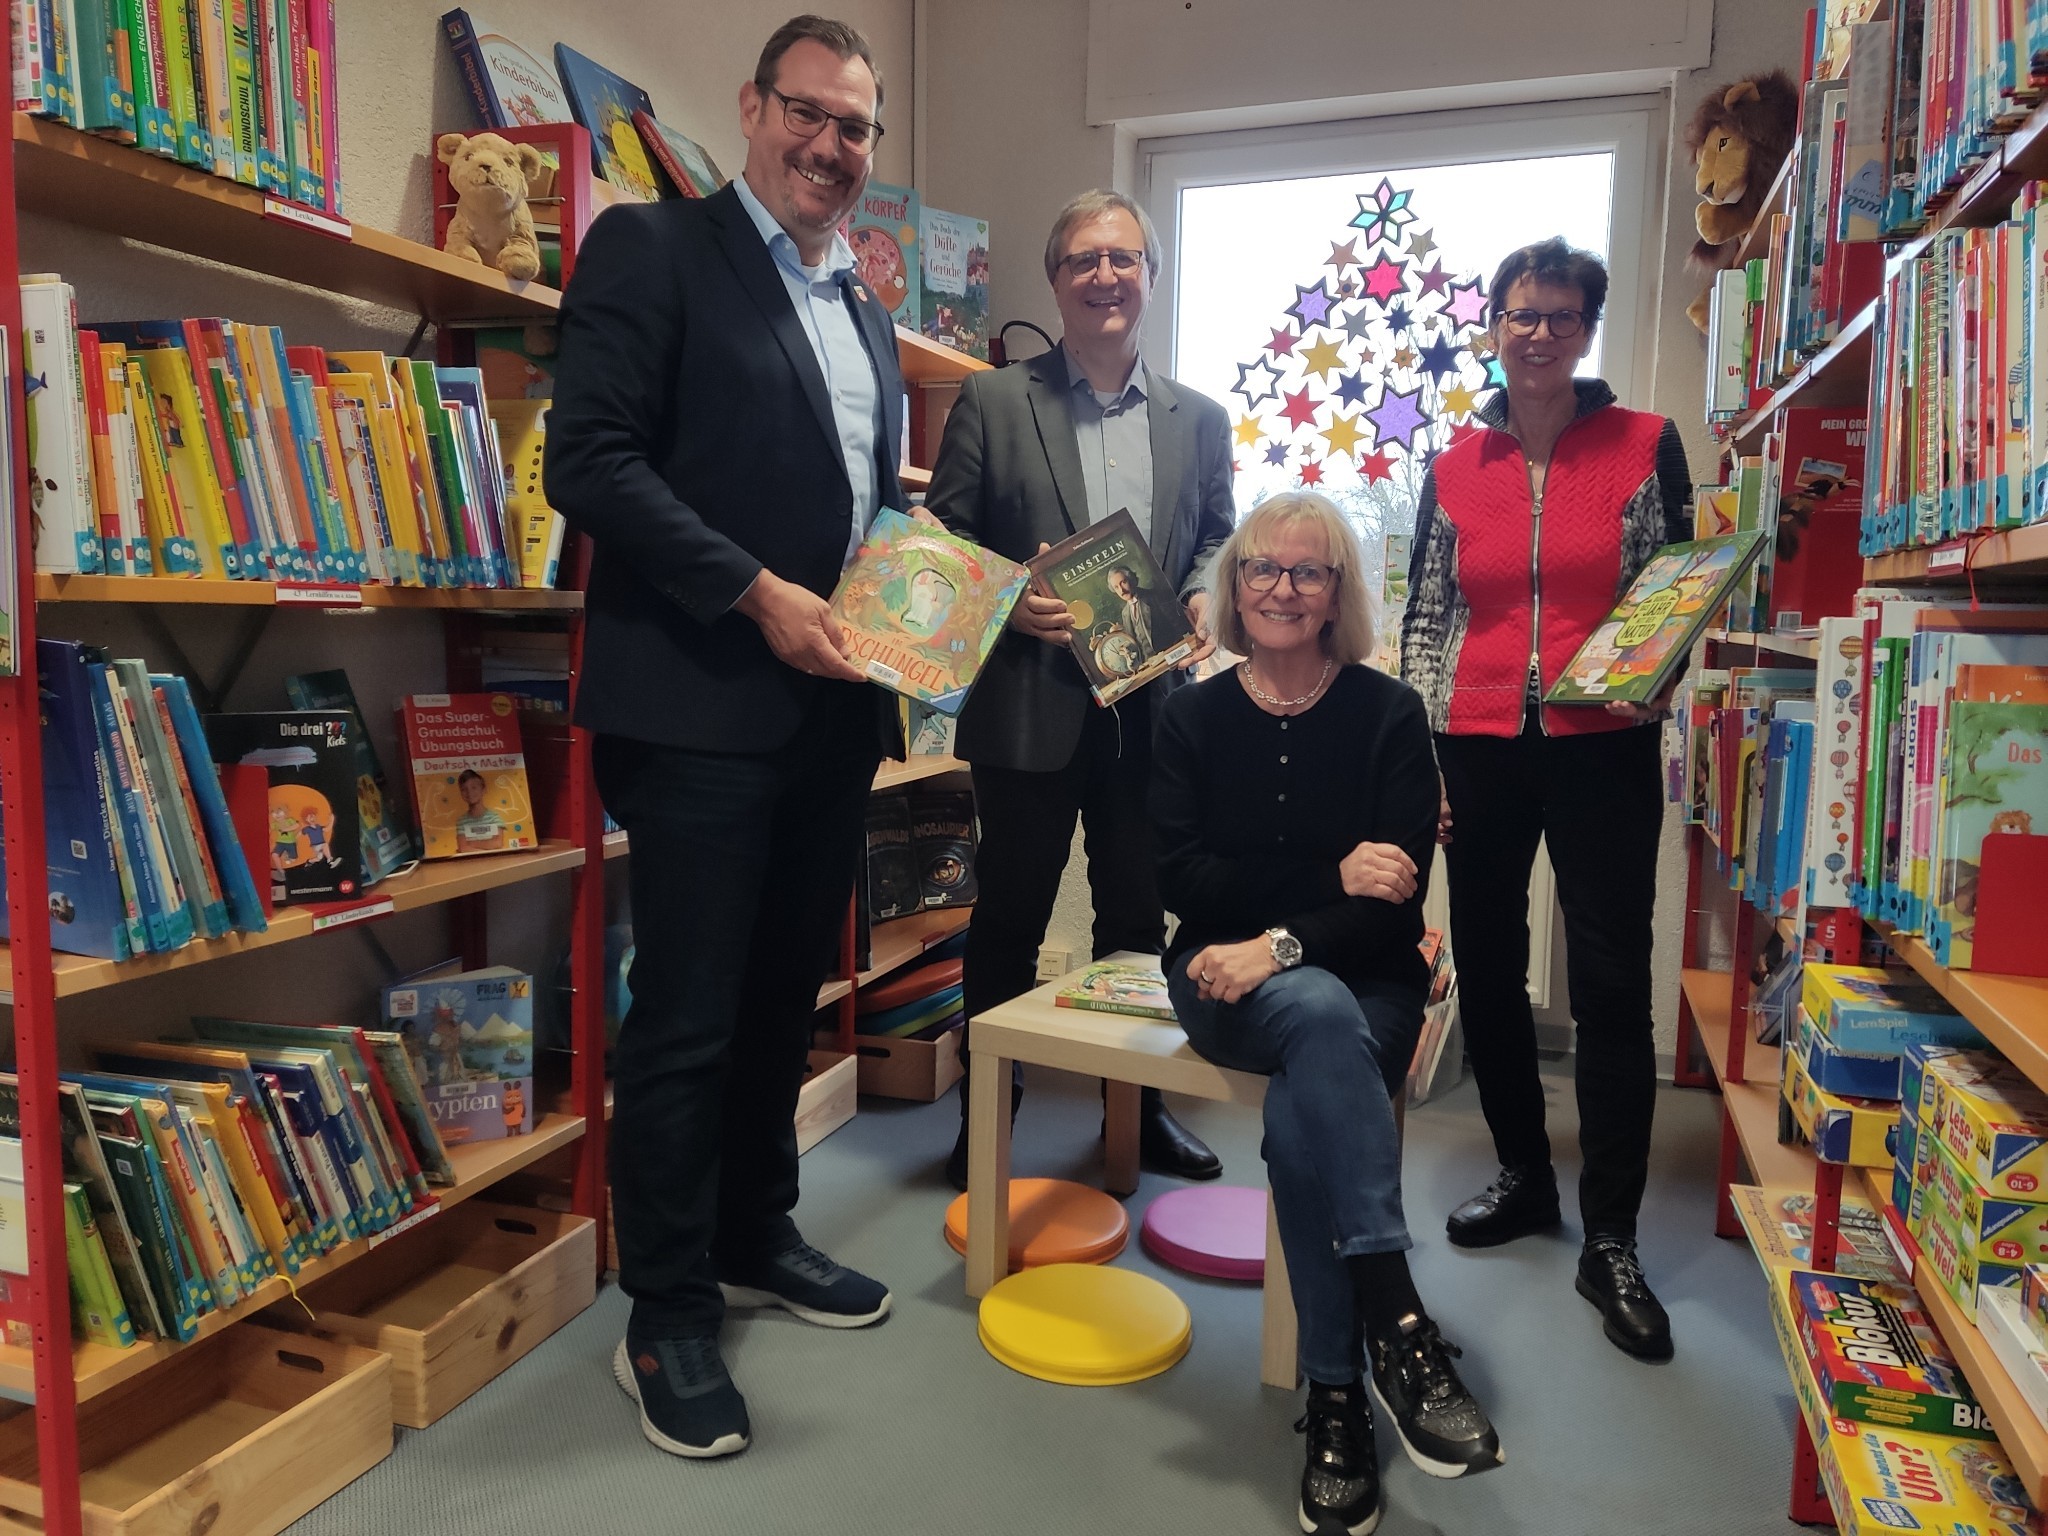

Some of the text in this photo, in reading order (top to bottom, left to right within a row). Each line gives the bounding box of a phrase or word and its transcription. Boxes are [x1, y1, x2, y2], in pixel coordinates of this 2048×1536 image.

[134, 0, 146, 52] ENGLISCH
[177, 4, 195, 119] MEIN KINDER
[290, 10, 303, 96] Warum haben Tiger
[155, 69, 164, 96] haben
[255, 53, 263, 85] REKORDE
[459, 51, 490, 113] Kinderbibel
[490, 55, 559, 104] Kinderbibel
[238, 85, 252, 153] GRUNDSCHUL
[257, 86, 266, 128] ALLERHAND
[864, 195, 907, 222] KÖRPER
[929, 221, 939, 232] Das
[934, 234, 957, 252] Düfte
[930, 258, 961, 278] Gerüche
[1821, 419, 1846, 430] MEIN
[156, 466, 165, 494] Deutsch
[162, 497, 175, 536] schulwissen
[1062, 540, 1126, 581] EINSTEIN
[1642, 601, 1671, 615] JAHR
[1620, 624, 1655, 639] NATUR
[840, 626, 943, 692] DSCHUNGEL
[280, 721, 347, 736] Die drei ???
[415, 712, 490, 724] Das Super-
[418, 725, 501, 738] Grundschul-
[326, 734, 347, 748] Kids
[419, 738, 504, 753] Übungsbuch
[1906, 698, 1917, 772] SPORT
[424, 758, 471, 771] Deutsch
[480, 756, 517, 768] Mathe
[2007, 742, 2042, 764] Das
[93, 750, 106, 799] Kinderatlas
[98, 800, 111, 840] Diercke
[914, 822, 969, 837] INOSAURIER
[1825, 925, 1836, 939] 5
[476, 982, 506, 995] FRAG
[1850, 1016, 1908, 1031] LernSpiel
[428, 1093, 498, 1121] ypten
[1950, 1101, 1973, 1142] Lese-
[1948, 1126, 1969, 1161] Ratte
[2010, 1179, 2034, 1189] 6-10
[1934, 1239, 1955, 1286] Welt
[1884, 1441, 1943, 1502] Uhr?
